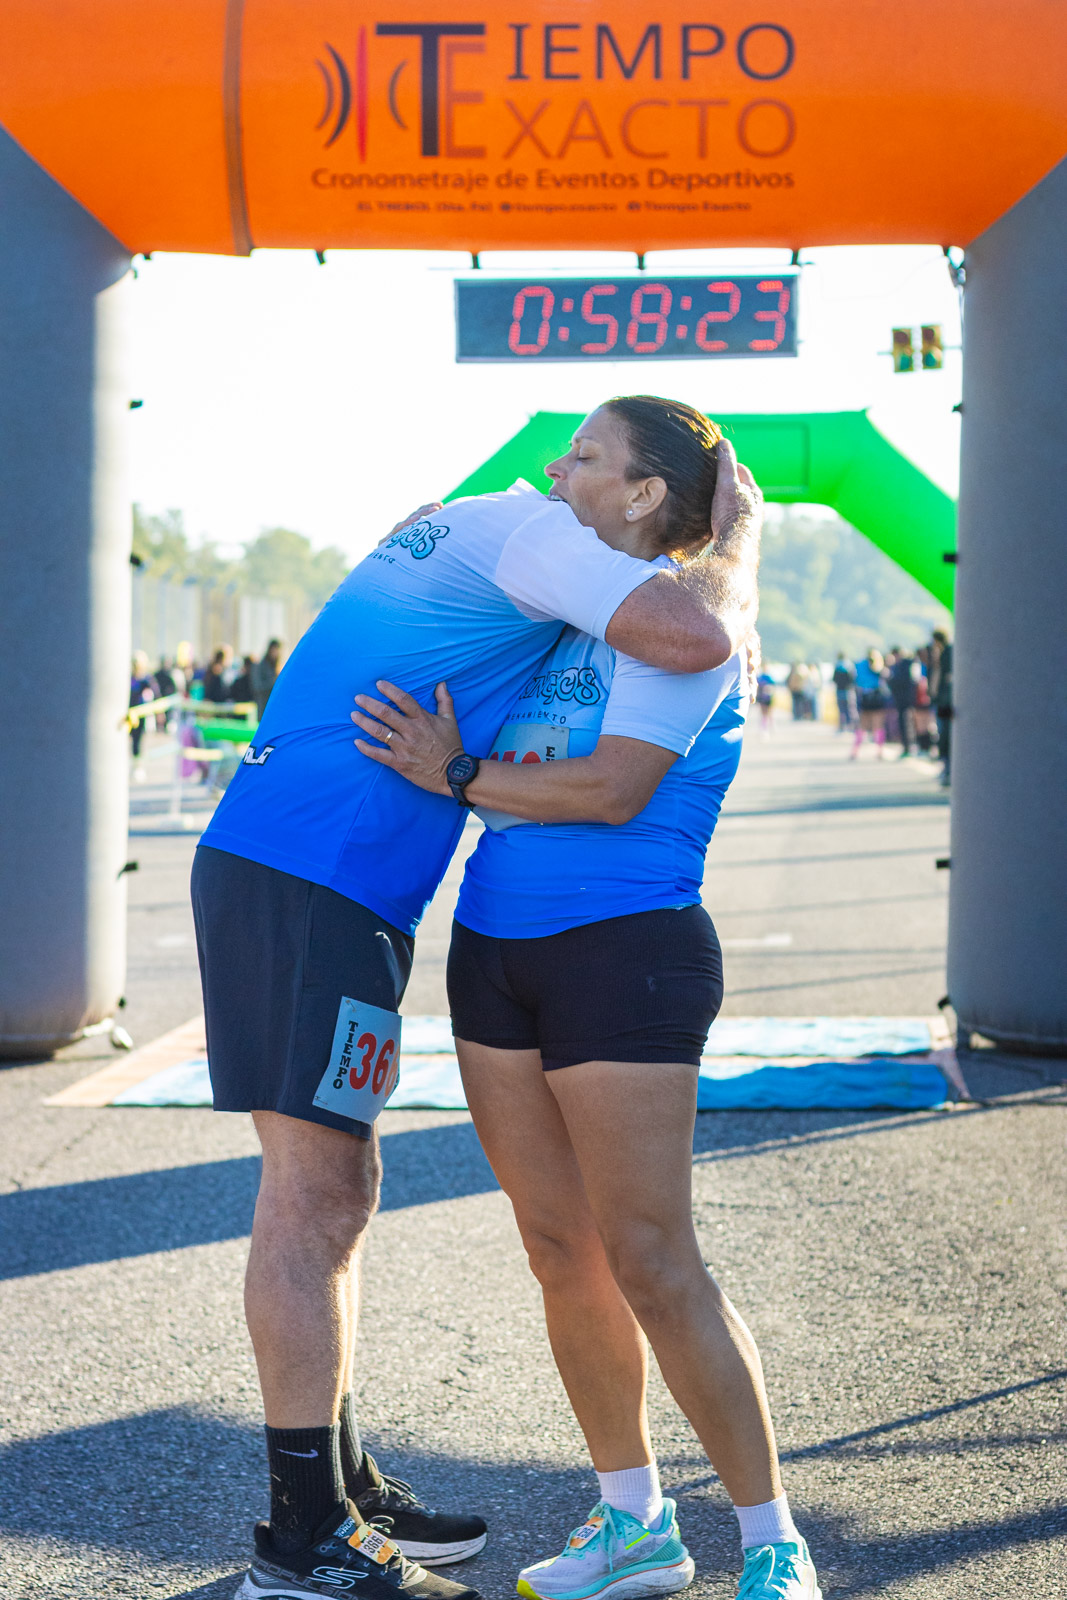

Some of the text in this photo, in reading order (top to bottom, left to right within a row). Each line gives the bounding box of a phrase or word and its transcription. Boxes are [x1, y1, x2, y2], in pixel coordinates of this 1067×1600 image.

[311, 167, 795, 193] Cronometraje de Eventos Deportivos
[508, 280, 790, 355] 0:58:23
[333, 1021, 358, 1089] TIEMPO
[363, 1535, 384, 1554] 366
